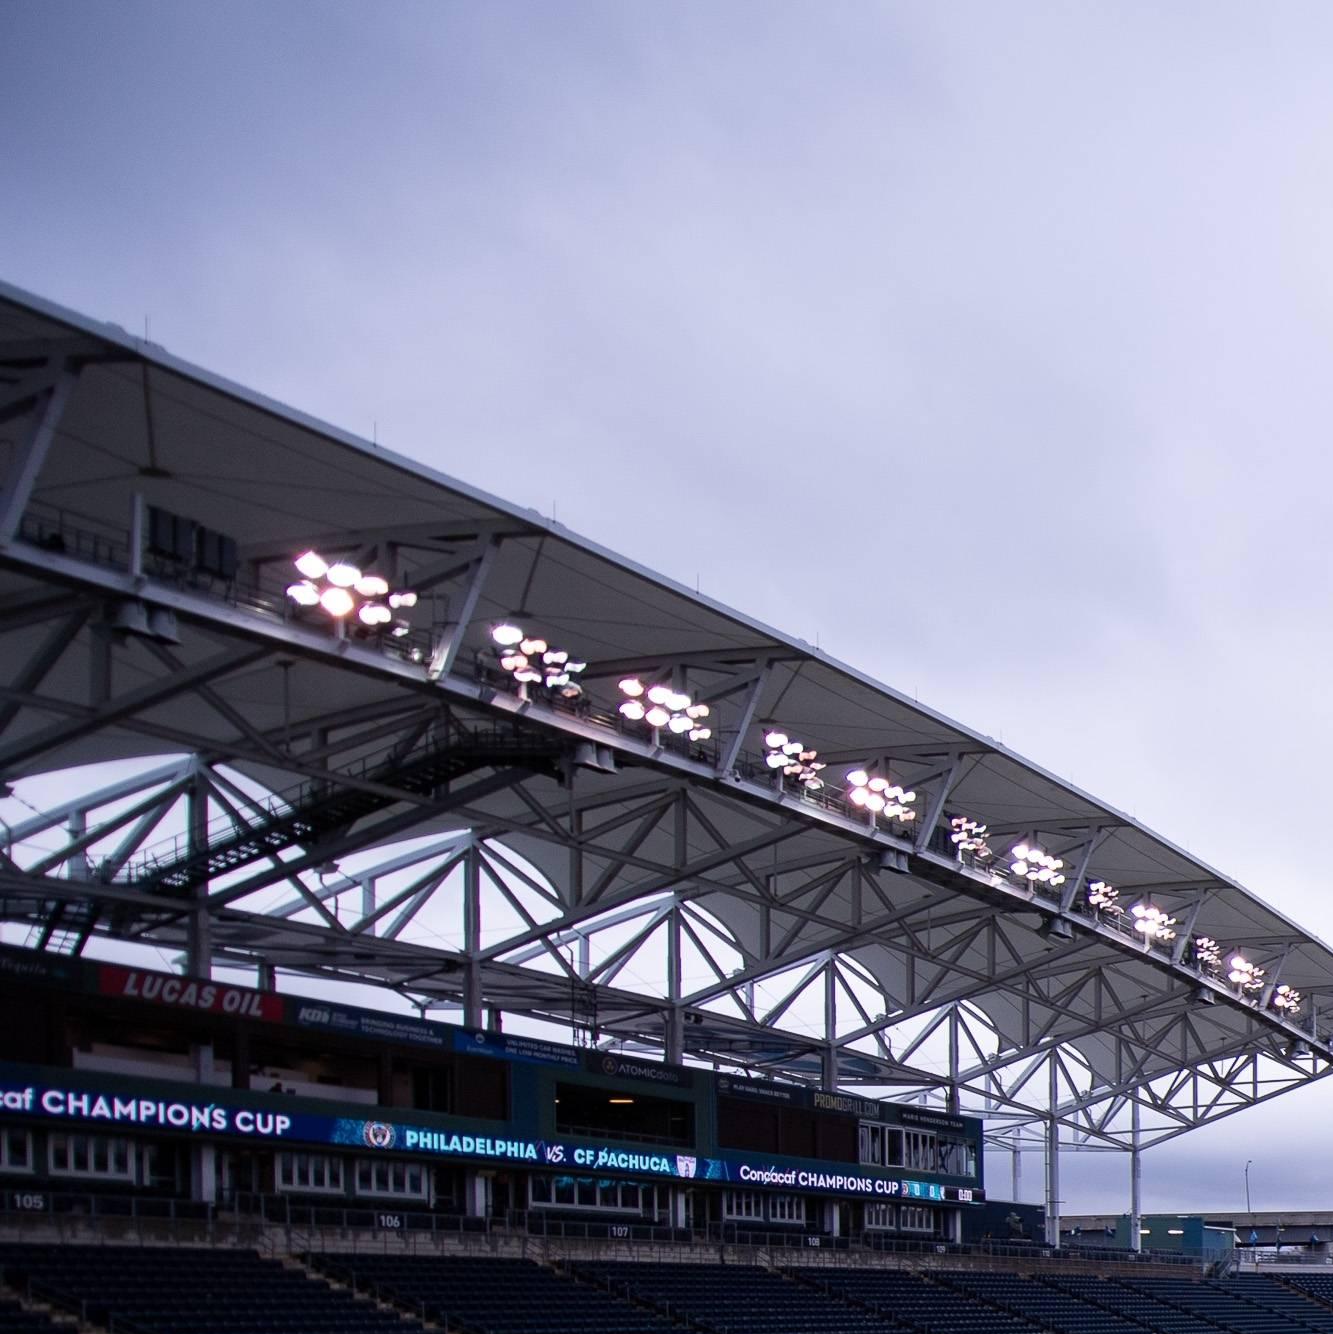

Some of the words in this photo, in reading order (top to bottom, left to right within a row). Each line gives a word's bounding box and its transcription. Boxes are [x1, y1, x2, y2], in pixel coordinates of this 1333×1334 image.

[123, 972, 216, 1009] LUCAS
[222, 993, 263, 1017] OIL
[618, 1063, 679, 1083] ATOMICdata
[42, 1090, 227, 1132] CHAMPIONS
[235, 1111, 291, 1137] CUP
[813, 1092, 880, 1119] PROMOGRILL.COM
[405, 1128, 538, 1161] PHILADELPHIA
[573, 1147, 596, 1165] CF
[598, 1149, 670, 1174] PACHUCA
[739, 1163, 797, 1187] Concacaf
[798, 1170, 872, 1193] CHAMPIONS
[874, 1179, 899, 1196] CUP
[15, 1194, 44, 1209] 105
[380, 1214, 401, 1228] 106
[611, 1224, 629, 1239] 107
